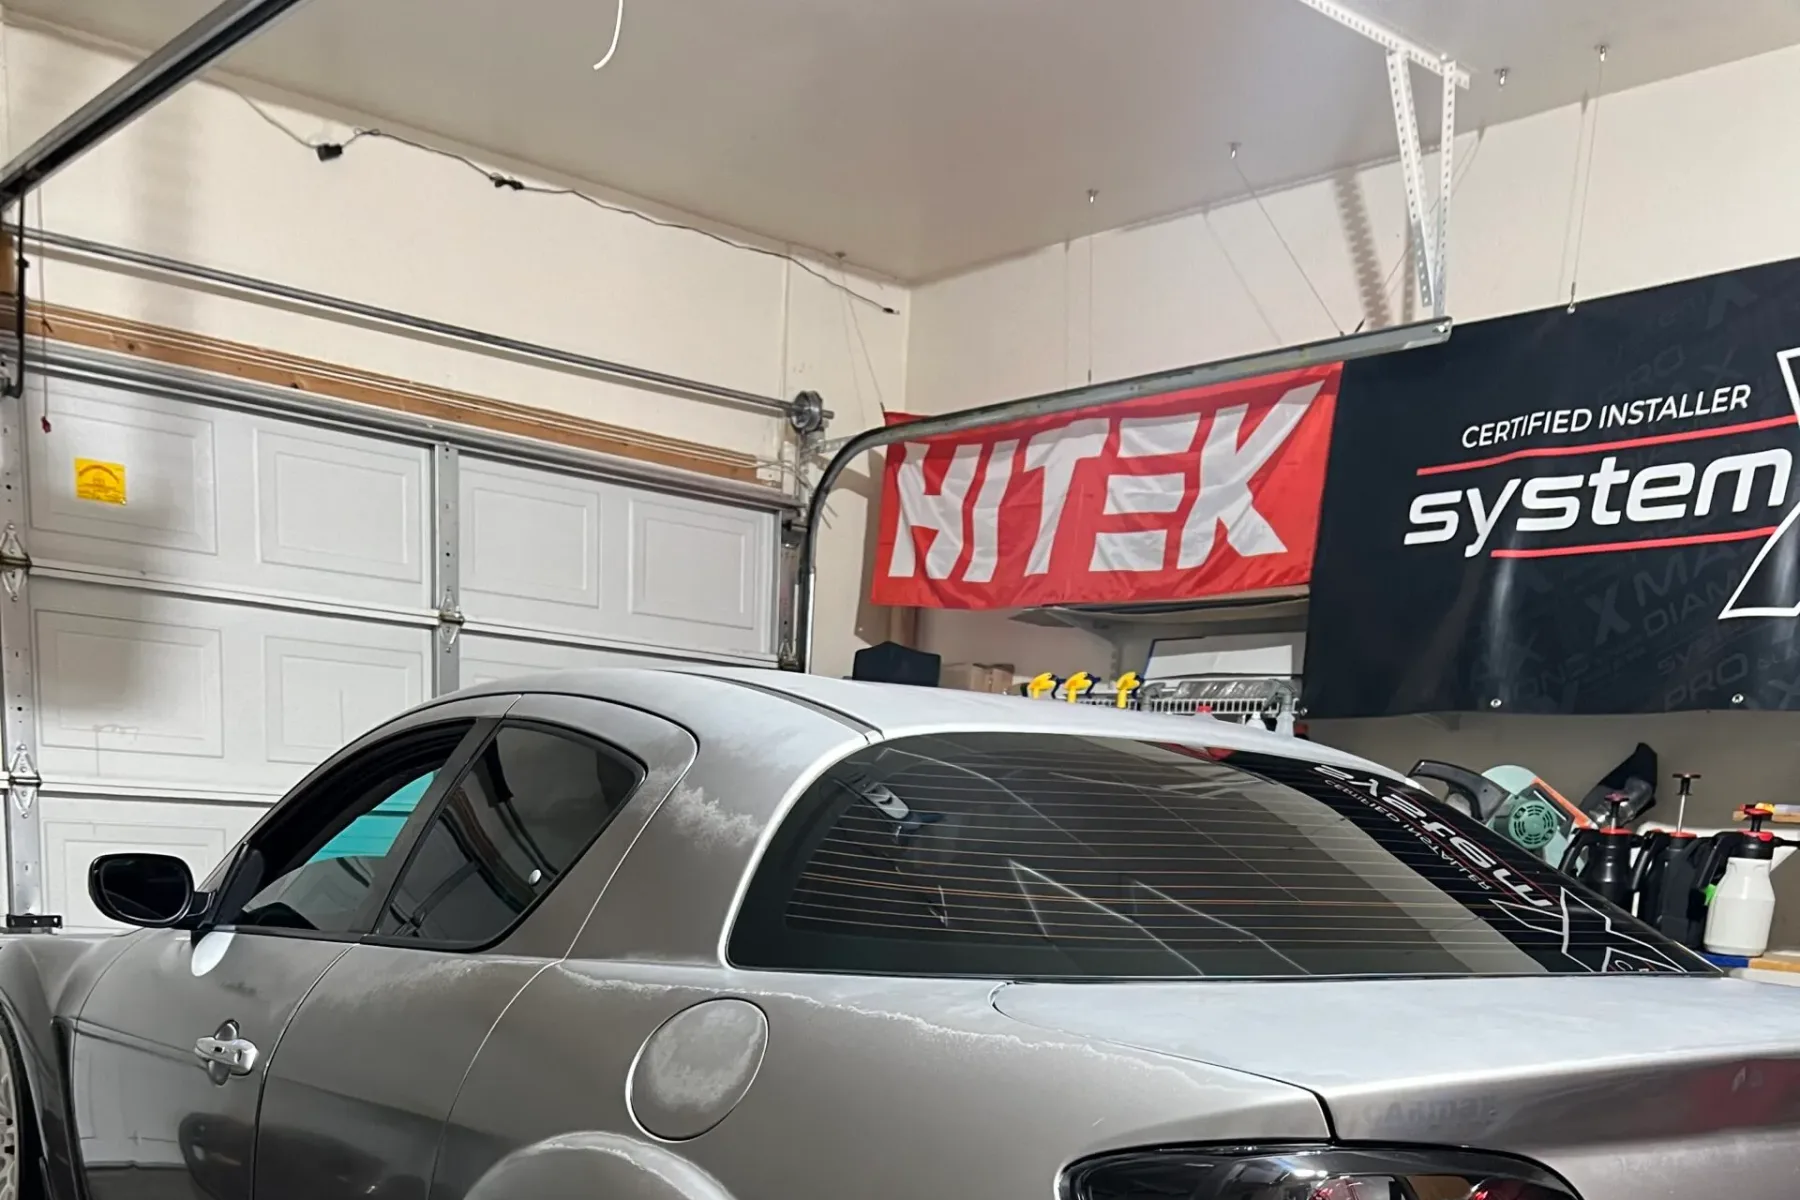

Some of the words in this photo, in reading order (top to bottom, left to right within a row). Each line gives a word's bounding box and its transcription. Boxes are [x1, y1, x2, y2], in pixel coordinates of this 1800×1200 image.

[887, 379, 1325, 583] HITEK
[1460, 407, 1593, 449] CERTIFIED
[1598, 384, 1752, 430] INSTALLER
